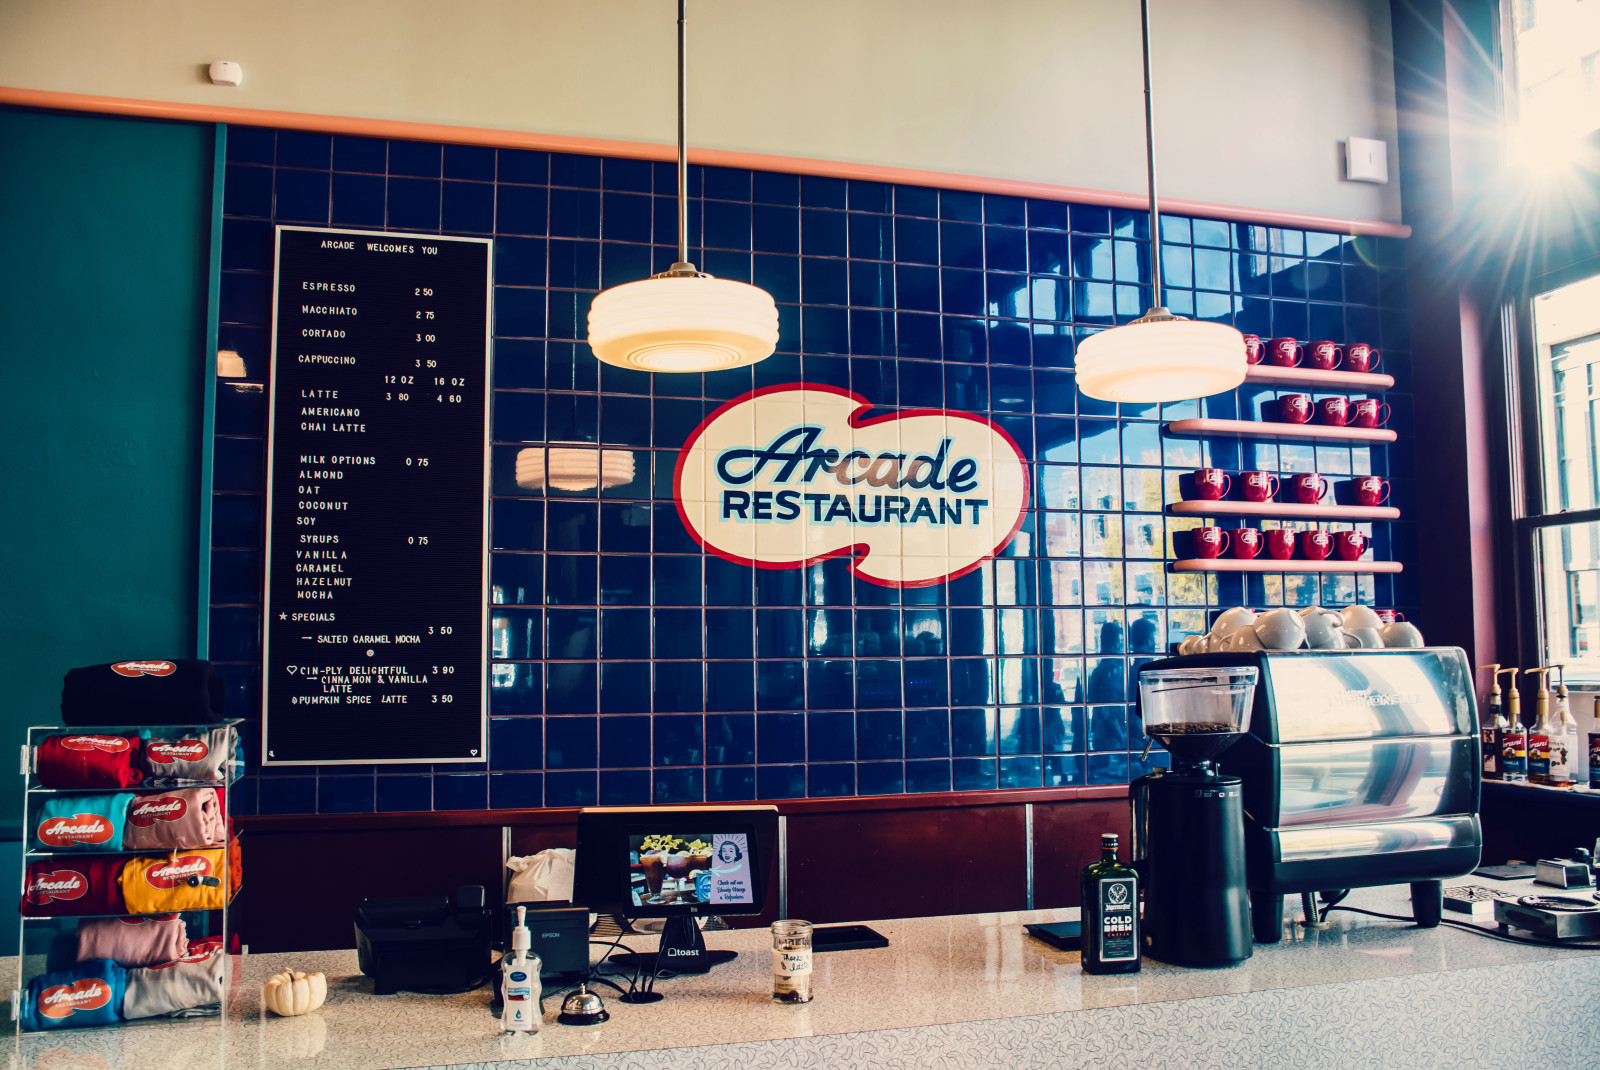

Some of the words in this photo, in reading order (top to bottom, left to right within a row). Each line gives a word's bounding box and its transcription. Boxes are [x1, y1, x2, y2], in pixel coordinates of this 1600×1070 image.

[321, 241, 355, 250] ARCADE
[367, 243, 415, 254] WELCOMES
[422, 247, 438, 256] YOU
[303, 282, 356, 293] ESPRESSO
[302, 305, 358, 316] MACCHIATO
[302, 329, 346, 339] CORTADO
[299, 355, 356, 365] CAPPUCCINO
[401, 376, 415, 385] OZ
[452, 378, 465, 387] OZ
[302, 390, 339, 399] LATTE
[302, 407, 361, 417] AMERICANO
[301, 422, 326, 432] CHAI
[333, 424, 366, 433] LATTE
[301, 455, 326, 464] MILK
[332, 456, 376, 465] OPTIONS
[717, 427, 978, 492] Arcade
[300, 471, 344, 480] ALMOND
[299, 486, 321, 495] OAT
[299, 501, 349, 511] COCONUT
[723, 490, 989, 526] RESTAURANT
[297, 517, 316, 526] SOY
[300, 535, 340, 544] SYRUPS
[297, 551, 348, 560] VANILLA
[296, 564, 344, 574] CARAMEL
[297, 578, 353, 587] HAZELNUT
[298, 591, 334, 600] MOCHA
[292, 613, 336, 622] SPECIALS
[318, 635, 349, 644] SALTED
[353, 635, 392, 644] CARAMEL
[396, 635, 421, 645] MOCHA
[118, 662, 170, 670] Arcade
[300, 666, 344, 675] CIN-PLY
[349, 666, 408, 675] DELIGHTFUL
[321, 675, 372, 684] CINNAMON
[377, 675, 386, 684] &
[388, 675, 429, 684] VANILLA
[323, 684, 353, 693] LATTE
[300, 696, 340, 706] PUMPKIN
[347, 696, 372, 705] SPICE
[382, 695, 408, 704] LATTE
[68, 736, 123, 746] Arcade
[152, 743, 203, 753] Arcade
[133, 801, 182, 816] Arcade
[45, 820, 105, 835] Arcade
[152, 858, 206, 877] Arcade
[30, 875, 81, 891] Arcade
[1104, 916, 1132, 925] COLD
[1104, 924, 1132, 932] BREW
[676, 949, 700, 957] toast
[44, 984, 102, 1004] Arcade
